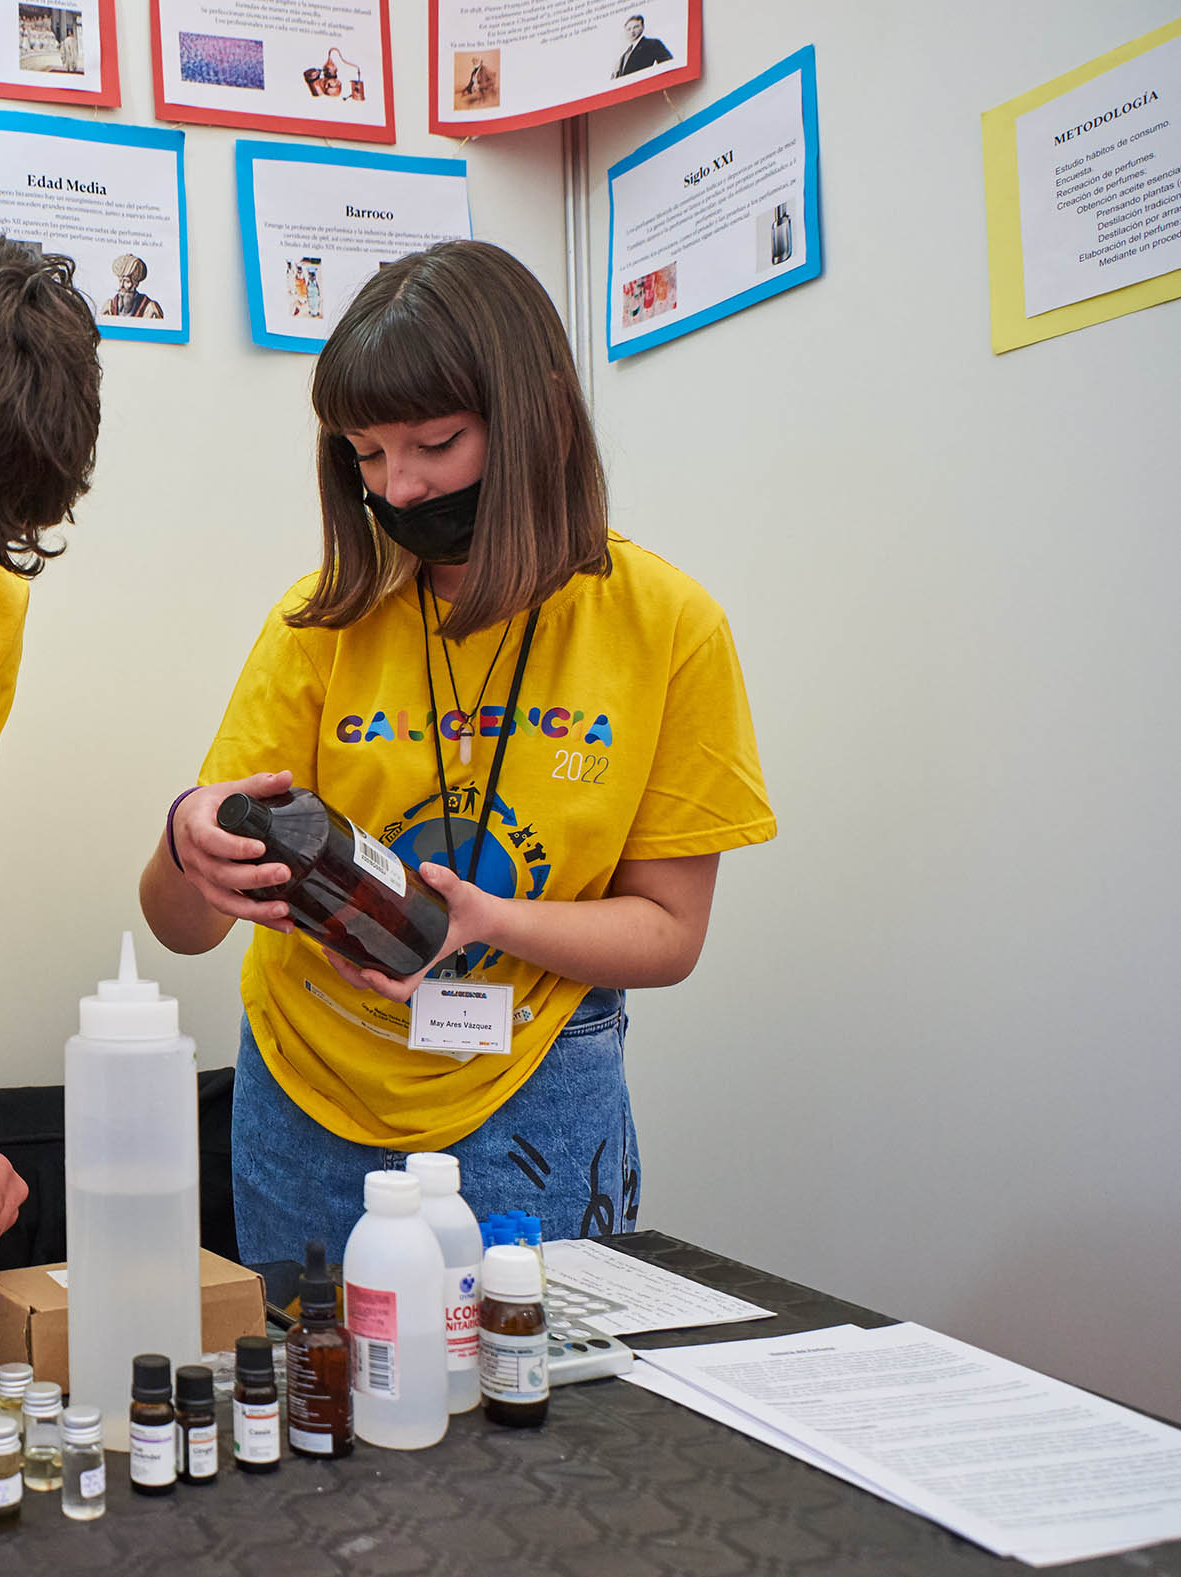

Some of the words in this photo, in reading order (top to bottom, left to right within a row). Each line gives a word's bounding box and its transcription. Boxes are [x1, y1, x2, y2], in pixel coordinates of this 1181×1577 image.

[1054, 90, 1160, 147] METODOLOGÍA
[1055, 157, 1083, 175] Estudio
[1086, 144, 1114, 161] hábitos
[1116, 138, 1127, 148] de
[1130, 120, 1170, 142] consumo.
[683, 162, 710, 188] Siglo
[711, 149, 735, 178] XXI
[27, 174, 63, 191] Edad
[66, 177, 107, 196] Media
[1056, 175, 1100, 199] Recreación
[1102, 170, 1112, 179] de
[1056, 191, 1091, 210] Creación
[1093, 186, 1103, 195] de
[1076, 192, 1117, 214] Obtención
[1119, 181, 1144, 197] aceite
[345, 204, 394, 222] Barroco
[1096, 196, 1140, 218] Prensando
[1143, 183, 1174, 203] plantas
[1098, 208, 1142, 230] Destilación
[1098, 220, 1143, 243] Destilación
[1145, 214, 1159, 227] por
[1079, 239, 1126, 262] Elaboración
[1128, 232, 1140, 244] del
[1099, 248, 1136, 267] Mediante
[1139, 243, 1149, 252] un
[552, 750, 610, 785] 2022
[430, 1019, 445, 1028] May
[446, 1020, 462, 1028] Ares
[463, 1021, 492, 1031] Vázquez
